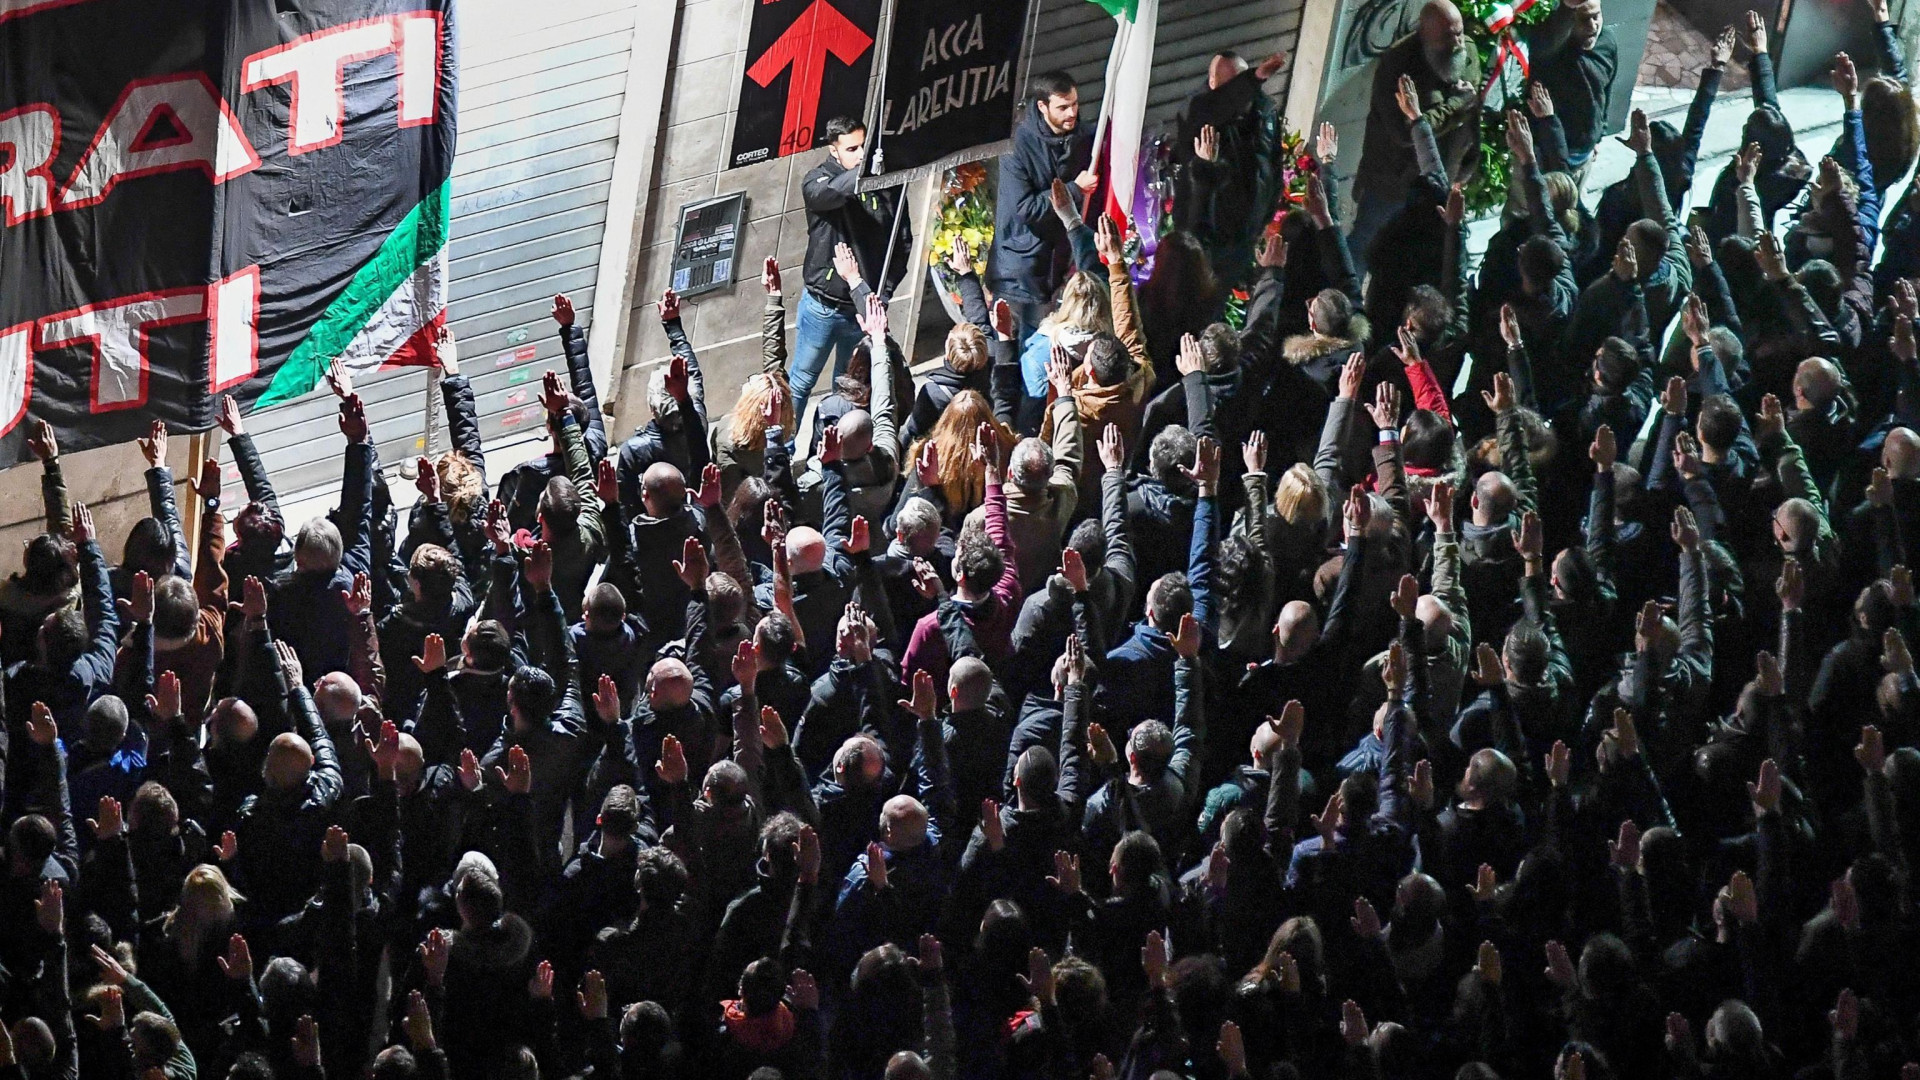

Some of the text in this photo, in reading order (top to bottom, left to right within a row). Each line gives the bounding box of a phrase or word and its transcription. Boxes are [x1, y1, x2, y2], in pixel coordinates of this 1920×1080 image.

[920, 13, 984, 72] ACCA
[881, 60, 1011, 135] LARENTIA
[736, 147, 769, 161] CORTEO
[781, 126, 812, 150] 40
